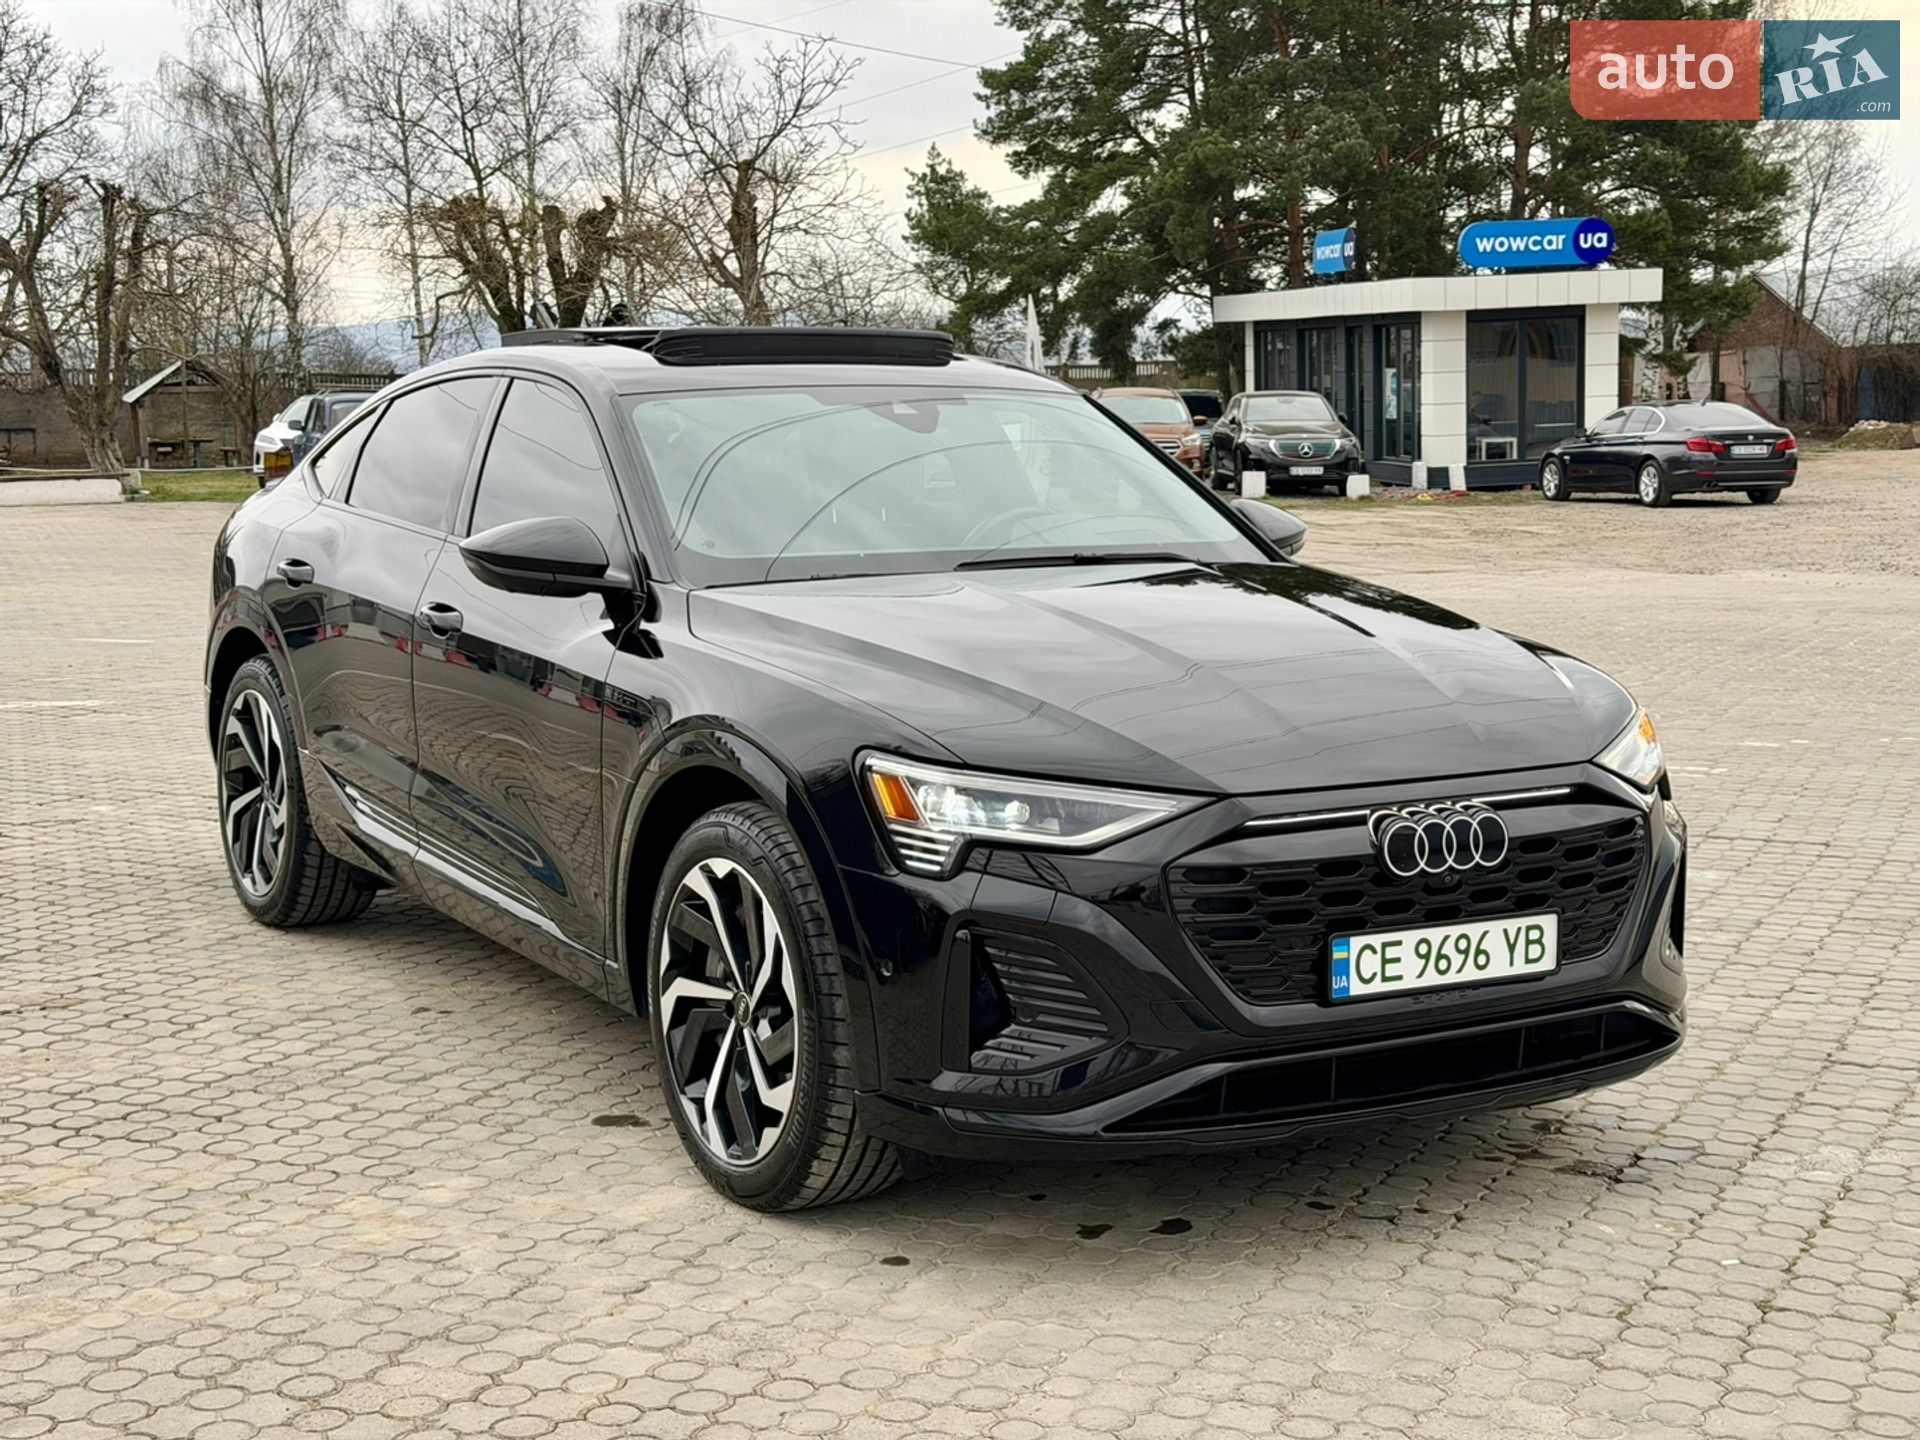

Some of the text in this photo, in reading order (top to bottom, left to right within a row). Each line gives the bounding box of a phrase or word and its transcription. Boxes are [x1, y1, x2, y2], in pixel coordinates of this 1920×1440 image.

[1475, 232, 1608, 253] wowcar ua
[1355, 923, 1546, 985] CE 9696 YB
[1332, 975, 1348, 989] UA
[786, 1008, 817, 1153] BRIDGESTONE
